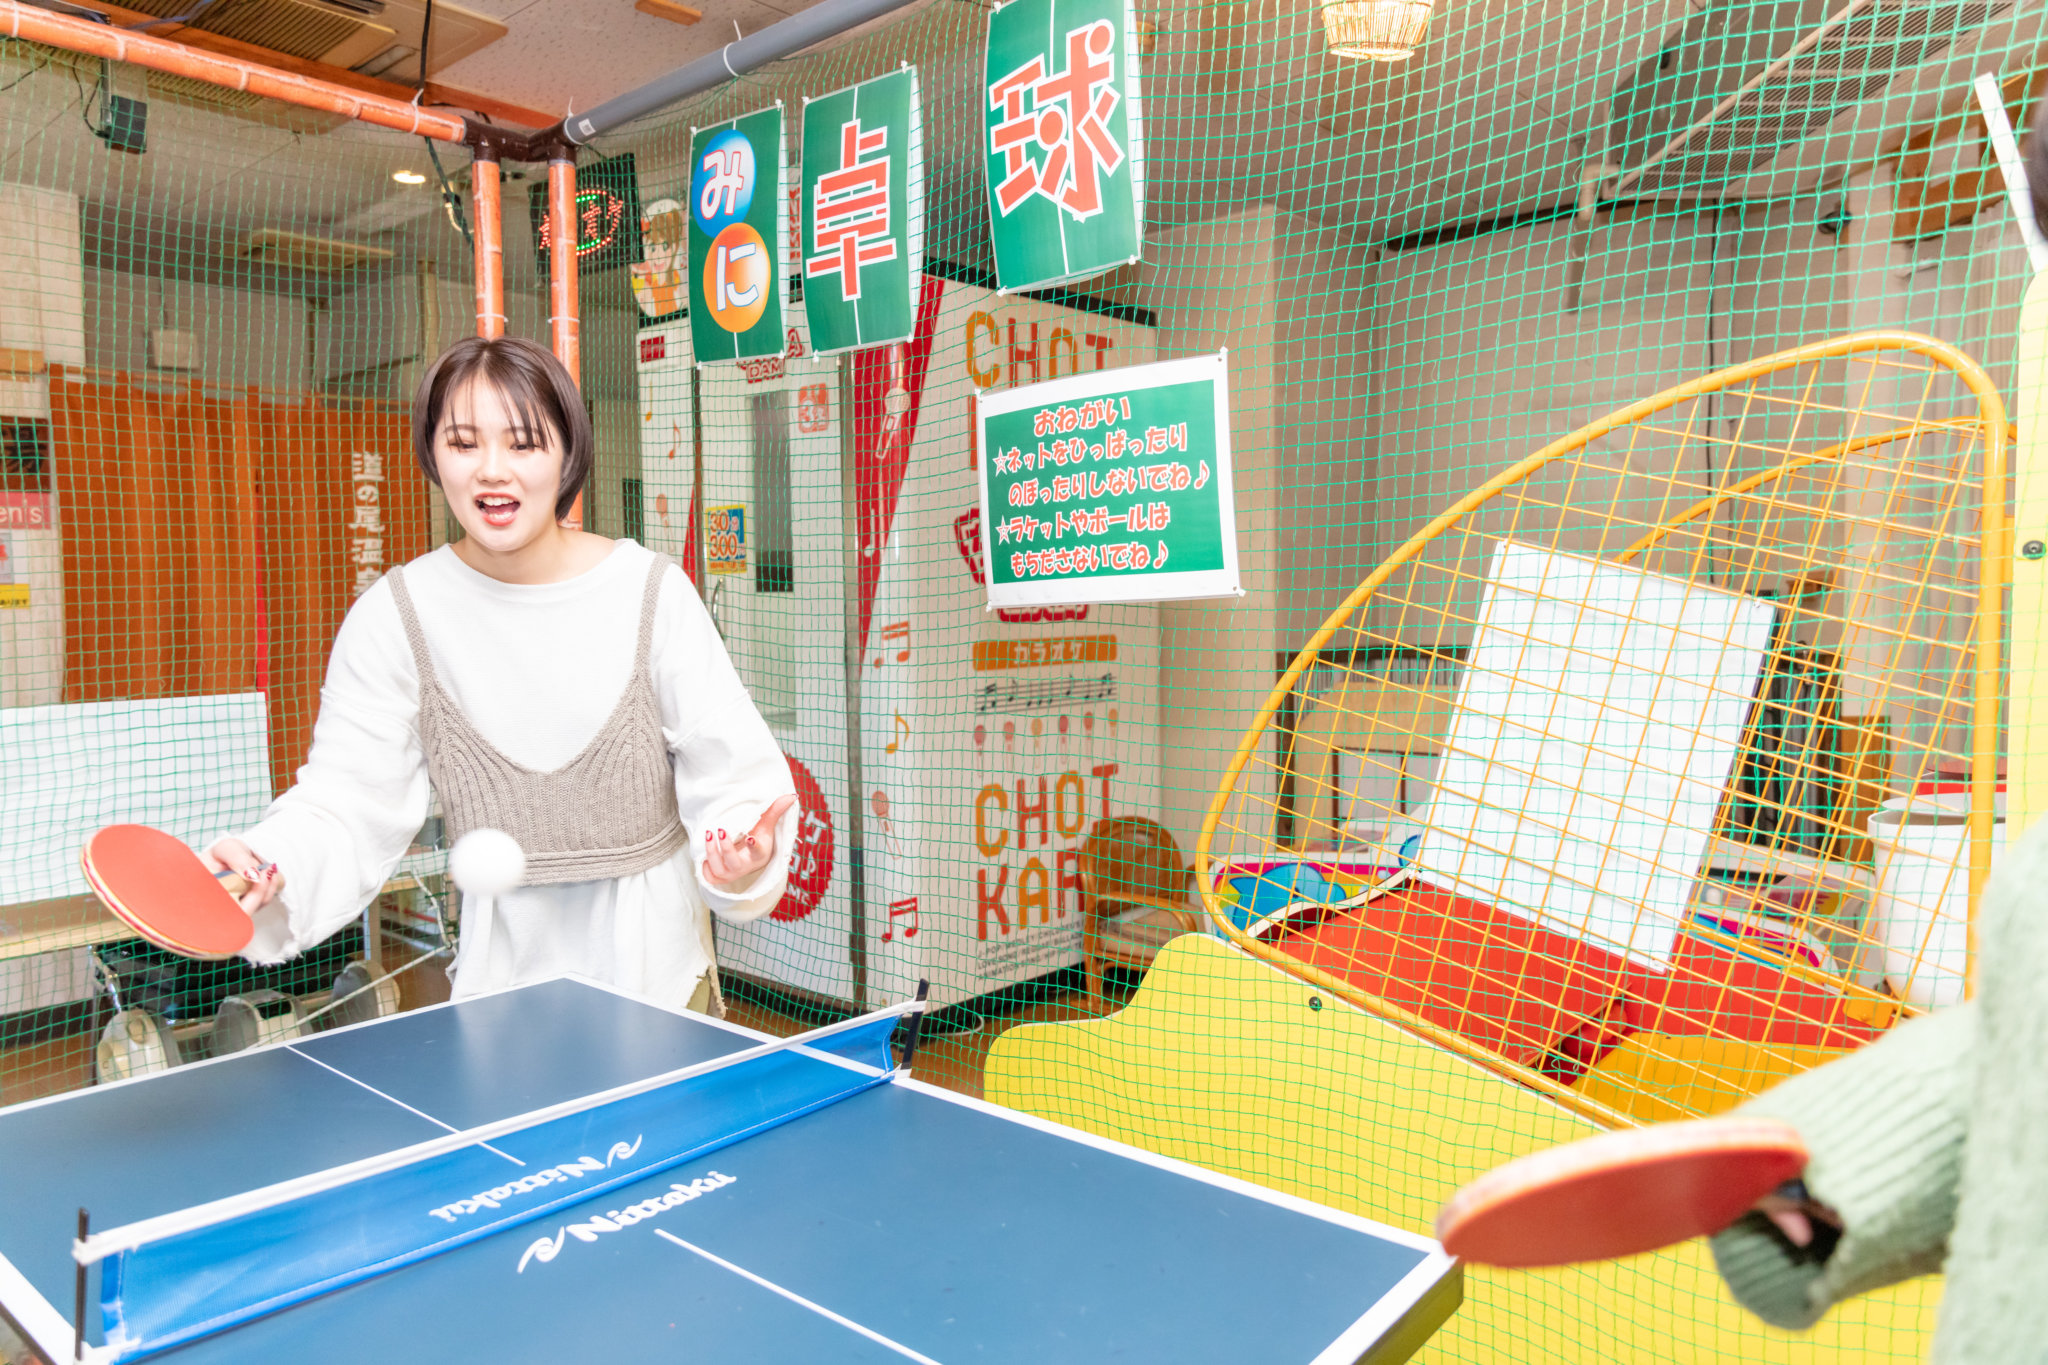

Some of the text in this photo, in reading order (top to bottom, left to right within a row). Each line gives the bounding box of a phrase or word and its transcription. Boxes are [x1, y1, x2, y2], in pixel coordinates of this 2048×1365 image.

[989, 19, 1125, 223] 球
[700, 149, 760, 312] みに
[806, 119, 897, 301] 卓
[1034, 396, 1131, 437] おねがい
[1007, 422, 1188, 474] ネットをひっぱったり
[0, 497, 43, 524] en's
[1008, 461, 1192, 508] のぼったりしないでね
[1010, 502, 1170, 543] ラケットやボールは
[1011, 540, 1151, 578] もちださないでね
[1013, 641, 1084, 664] カラオケ
[975, 763, 1119, 857] CHOT
[977, 847, 1085, 942] KAR
[428, 1156, 606, 1223] Nittaku
[566, 1171, 738, 1243] Nittaku
